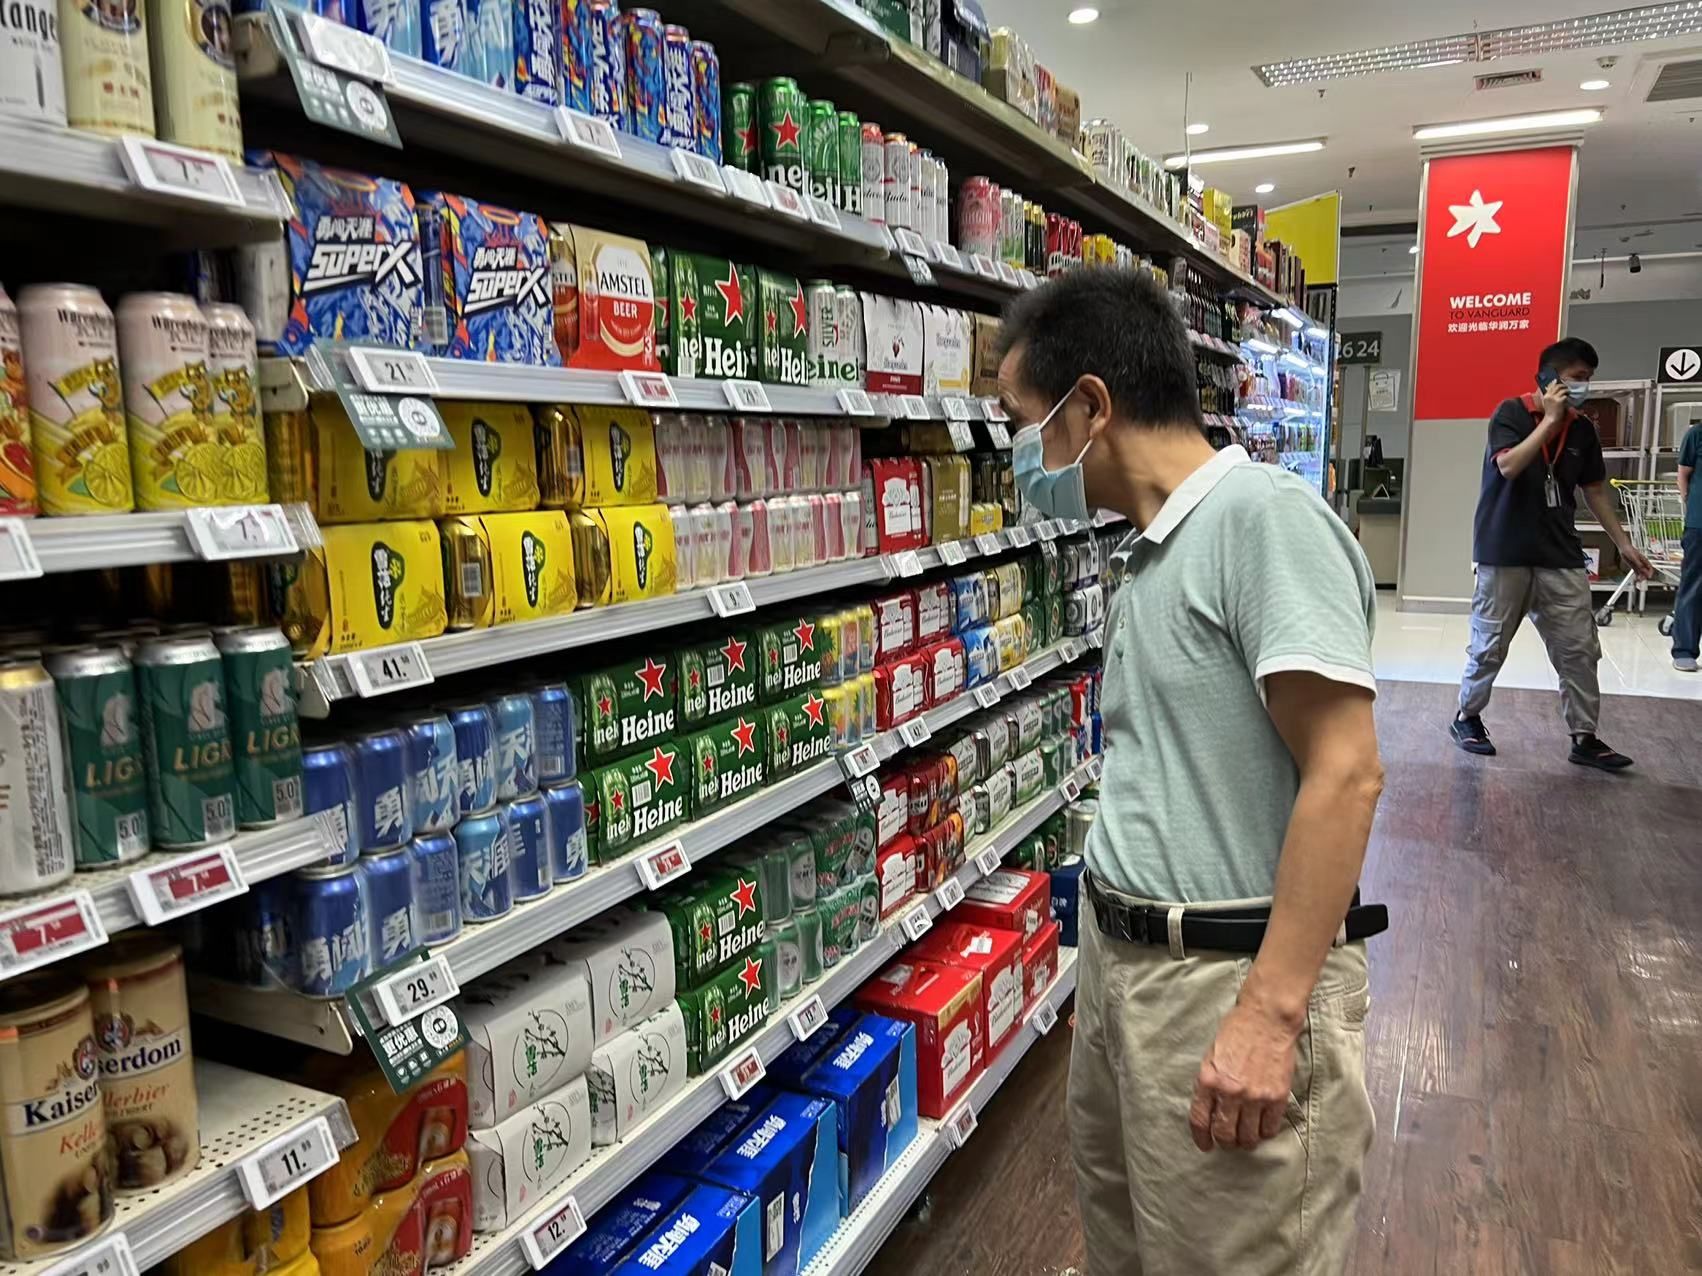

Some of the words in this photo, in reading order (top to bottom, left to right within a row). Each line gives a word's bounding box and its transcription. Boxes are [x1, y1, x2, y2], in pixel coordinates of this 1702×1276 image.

[315, 215, 374, 241] 勇闯天涯
[600, 271, 649, 298] AMSTEL
[613, 300, 638, 319] BEER
[1450, 292, 1532, 309] WELCOME
[1450, 311, 1464, 320] TO
[1468, 307, 1531, 320] VANGUARD
[1448, 319, 1530, 333] 欢迎光临华润万家
[1356, 340, 1380, 358] 24
[708, 683, 755, 716] Heine
[621, 708, 675, 747] Heine
[720, 761, 763, 799] Heine
[632, 795, 683, 838] Heine
